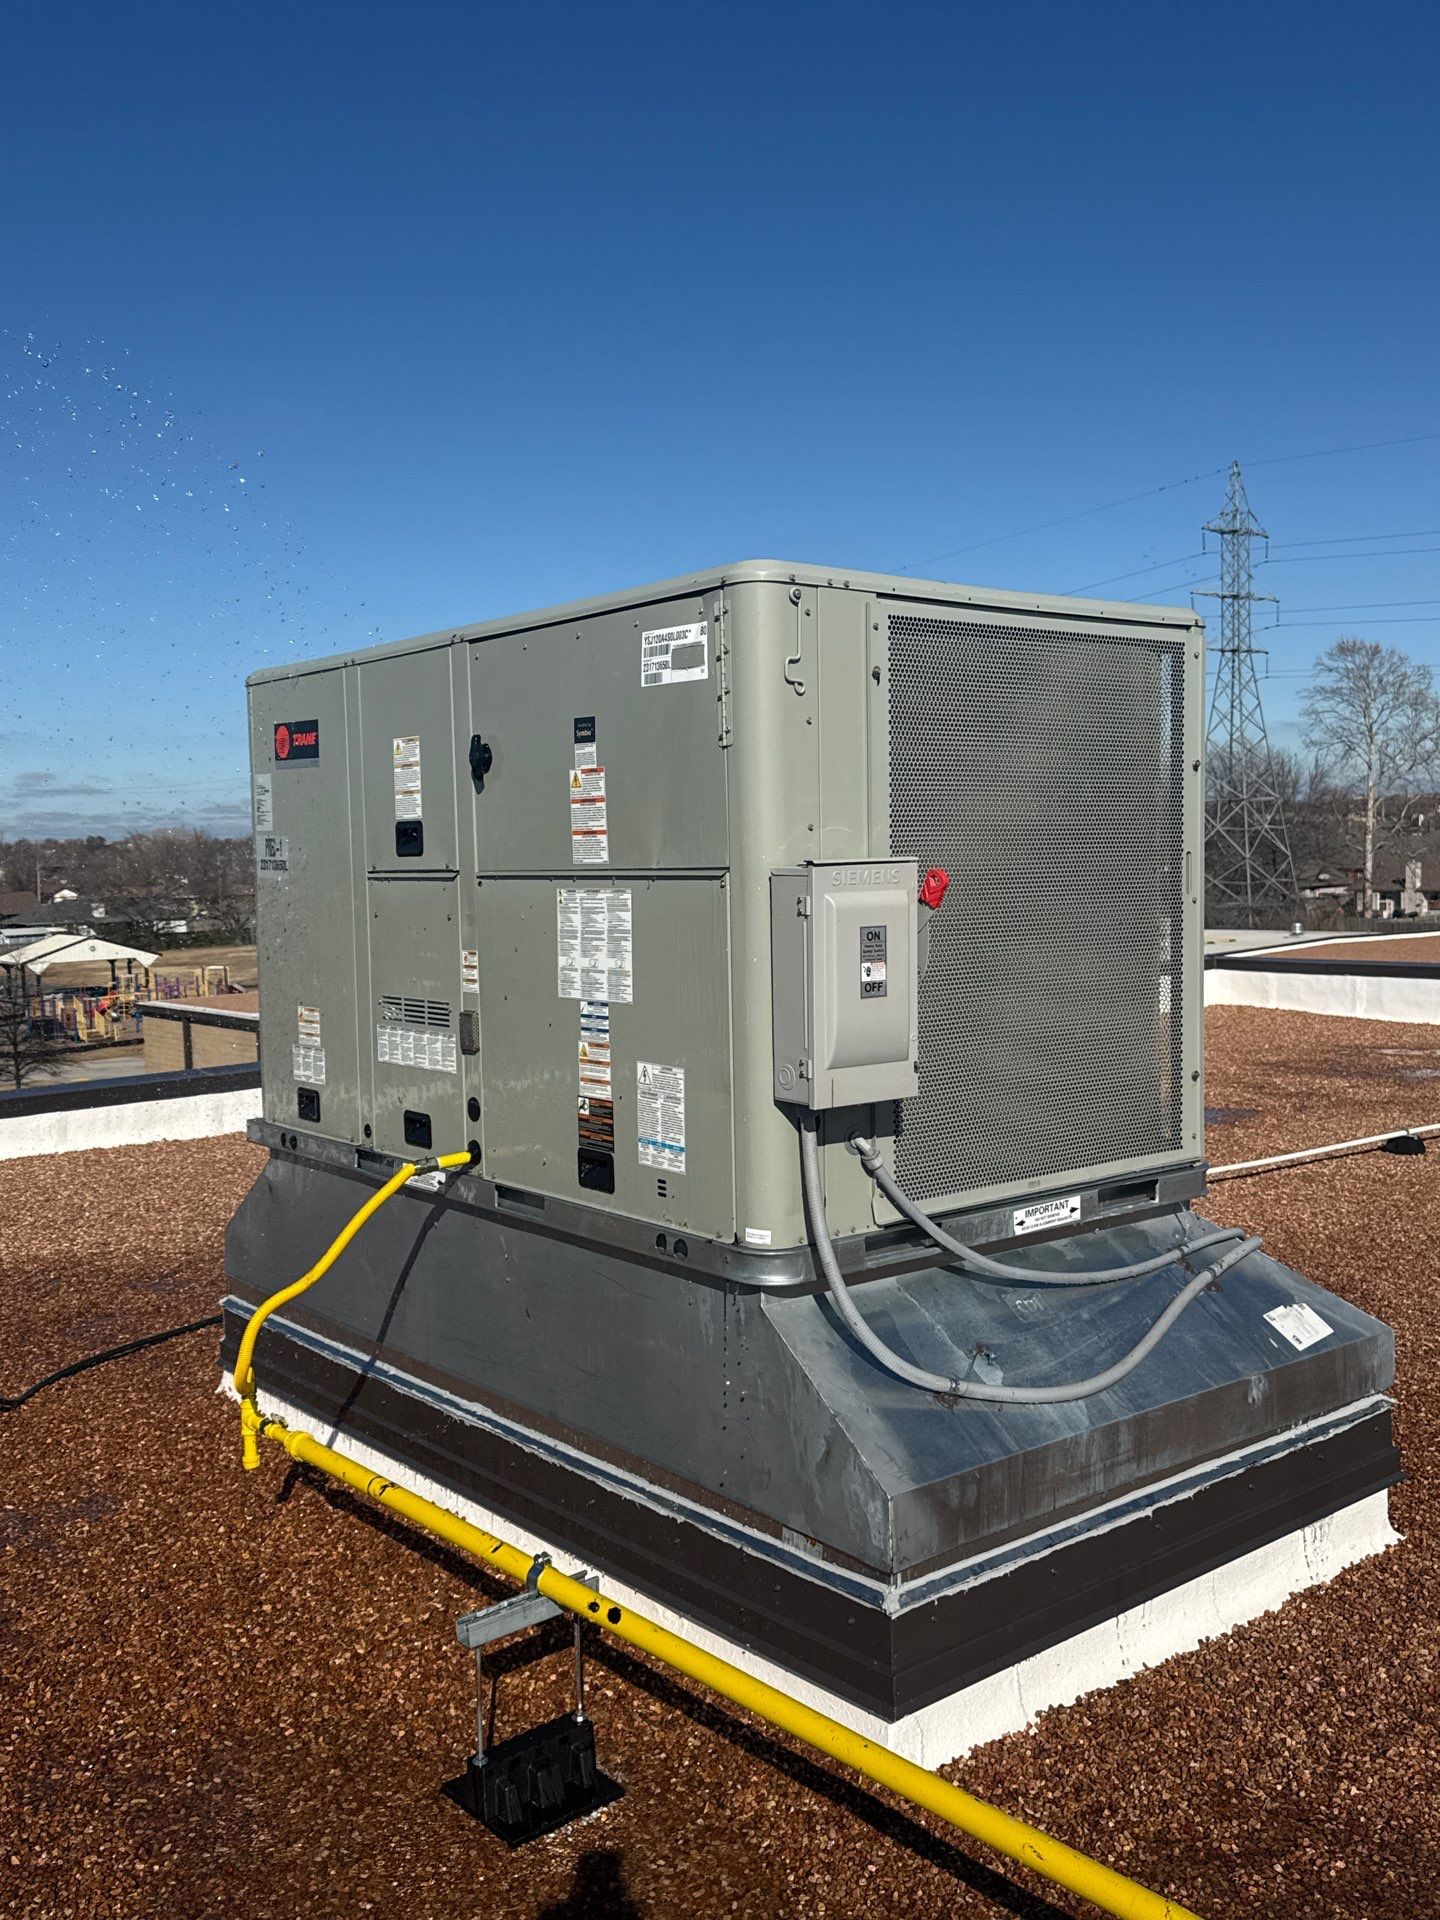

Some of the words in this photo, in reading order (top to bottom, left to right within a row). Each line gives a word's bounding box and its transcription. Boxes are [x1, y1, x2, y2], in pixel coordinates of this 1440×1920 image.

[292, 731, 317, 747] TRANE
[832, 869, 901, 886] SIEMENS
[866, 931, 881, 941] ON
[864, 981, 883, 993] OFF
[1025, 1200, 1070, 1219] IMPORTANT
